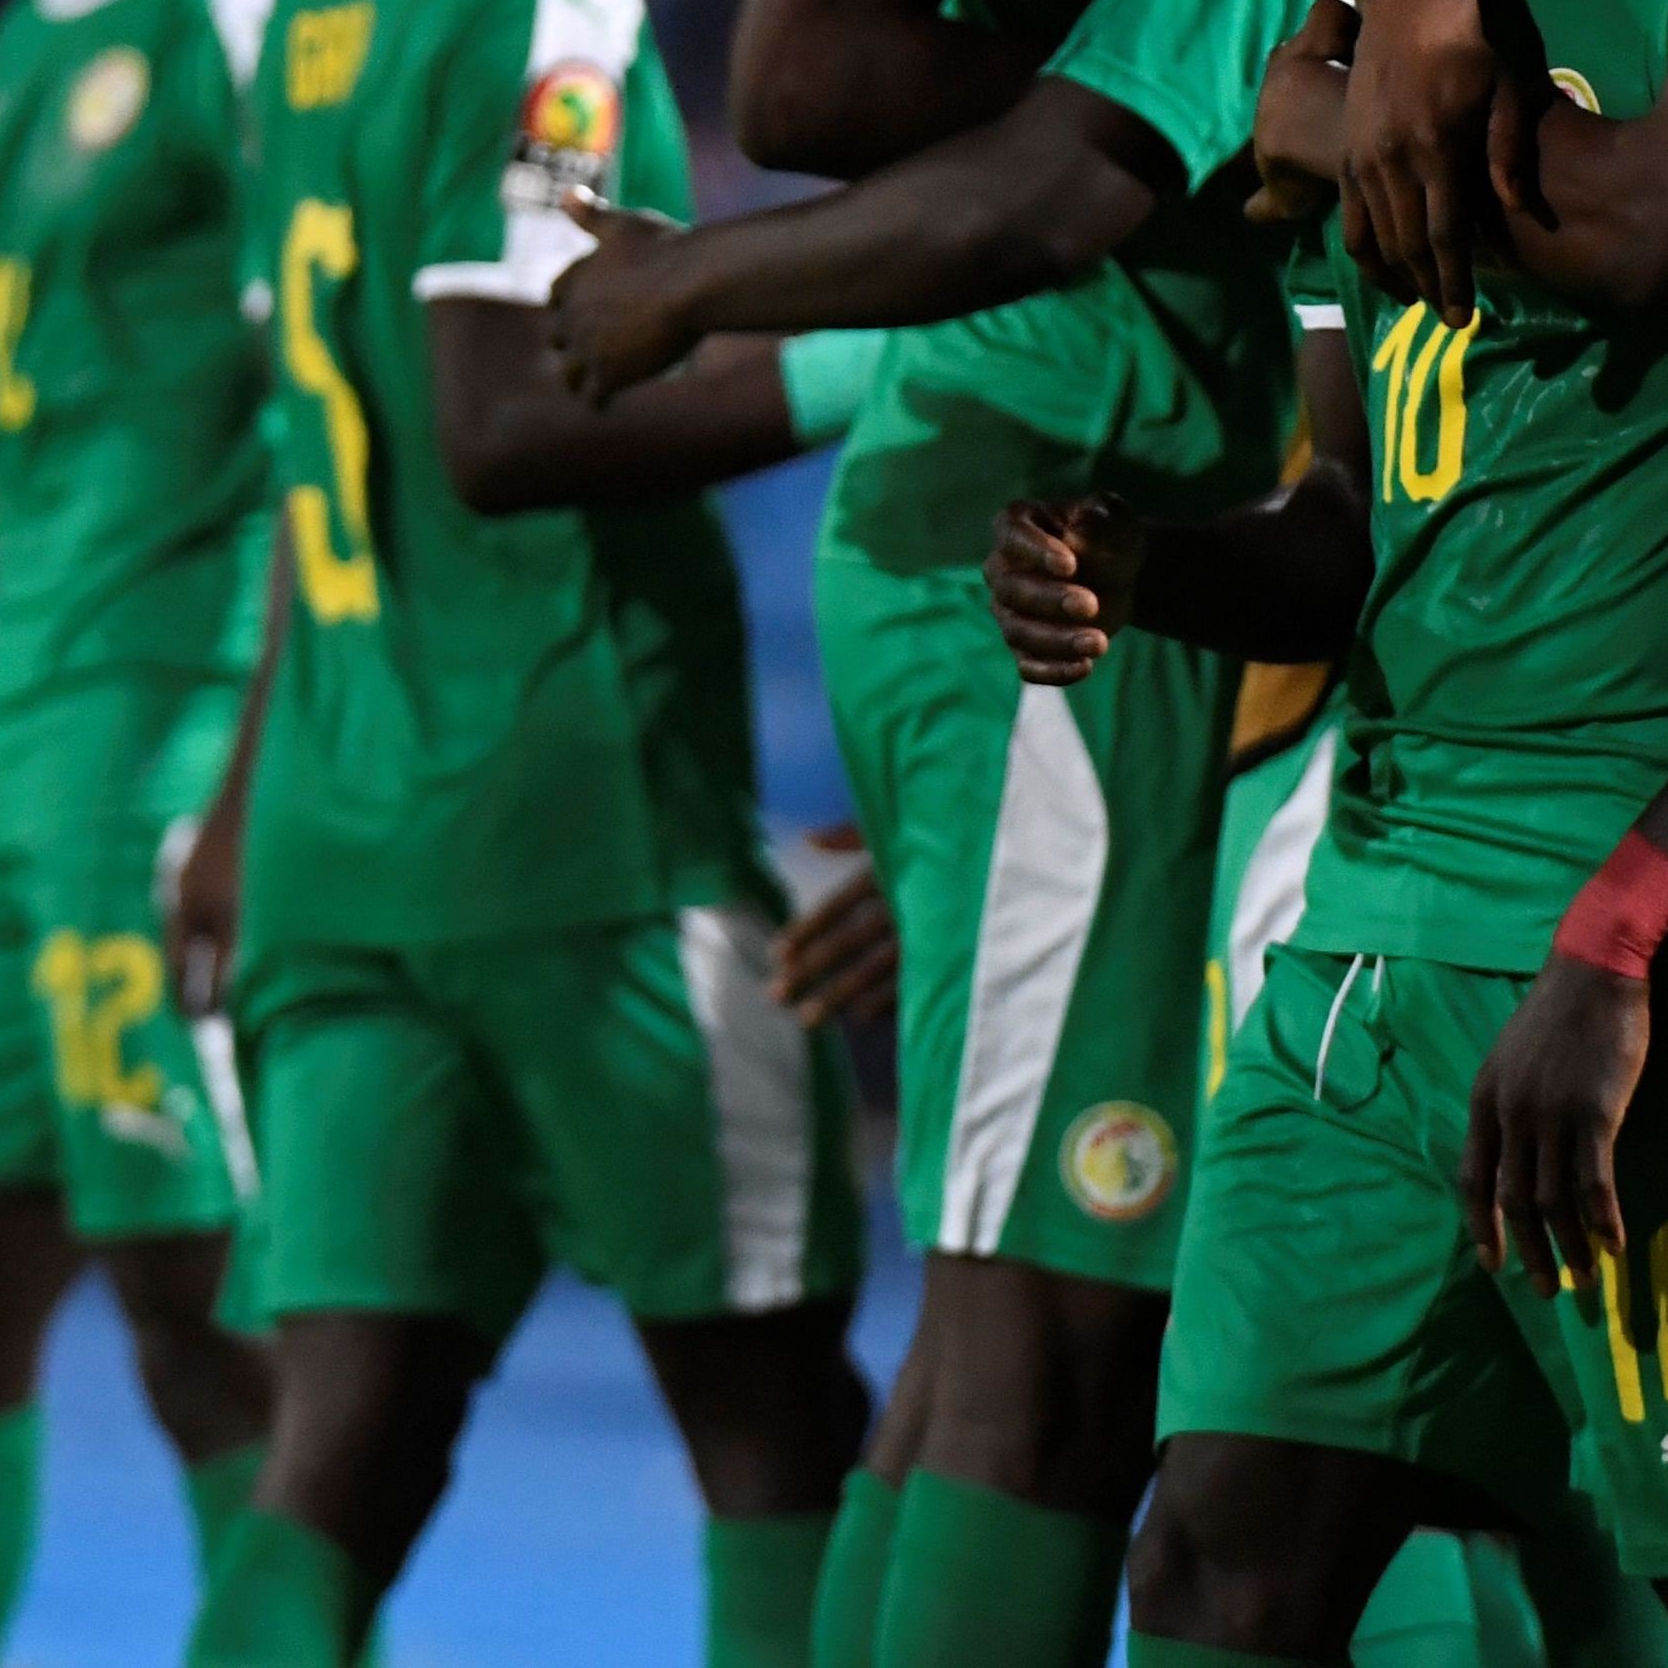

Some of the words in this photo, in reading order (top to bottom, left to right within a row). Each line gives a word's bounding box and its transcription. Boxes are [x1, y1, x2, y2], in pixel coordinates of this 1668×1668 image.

[279, 196, 380, 625] 5
[1372, 299, 1481, 503] 10
[30, 926, 164, 1108] 12
